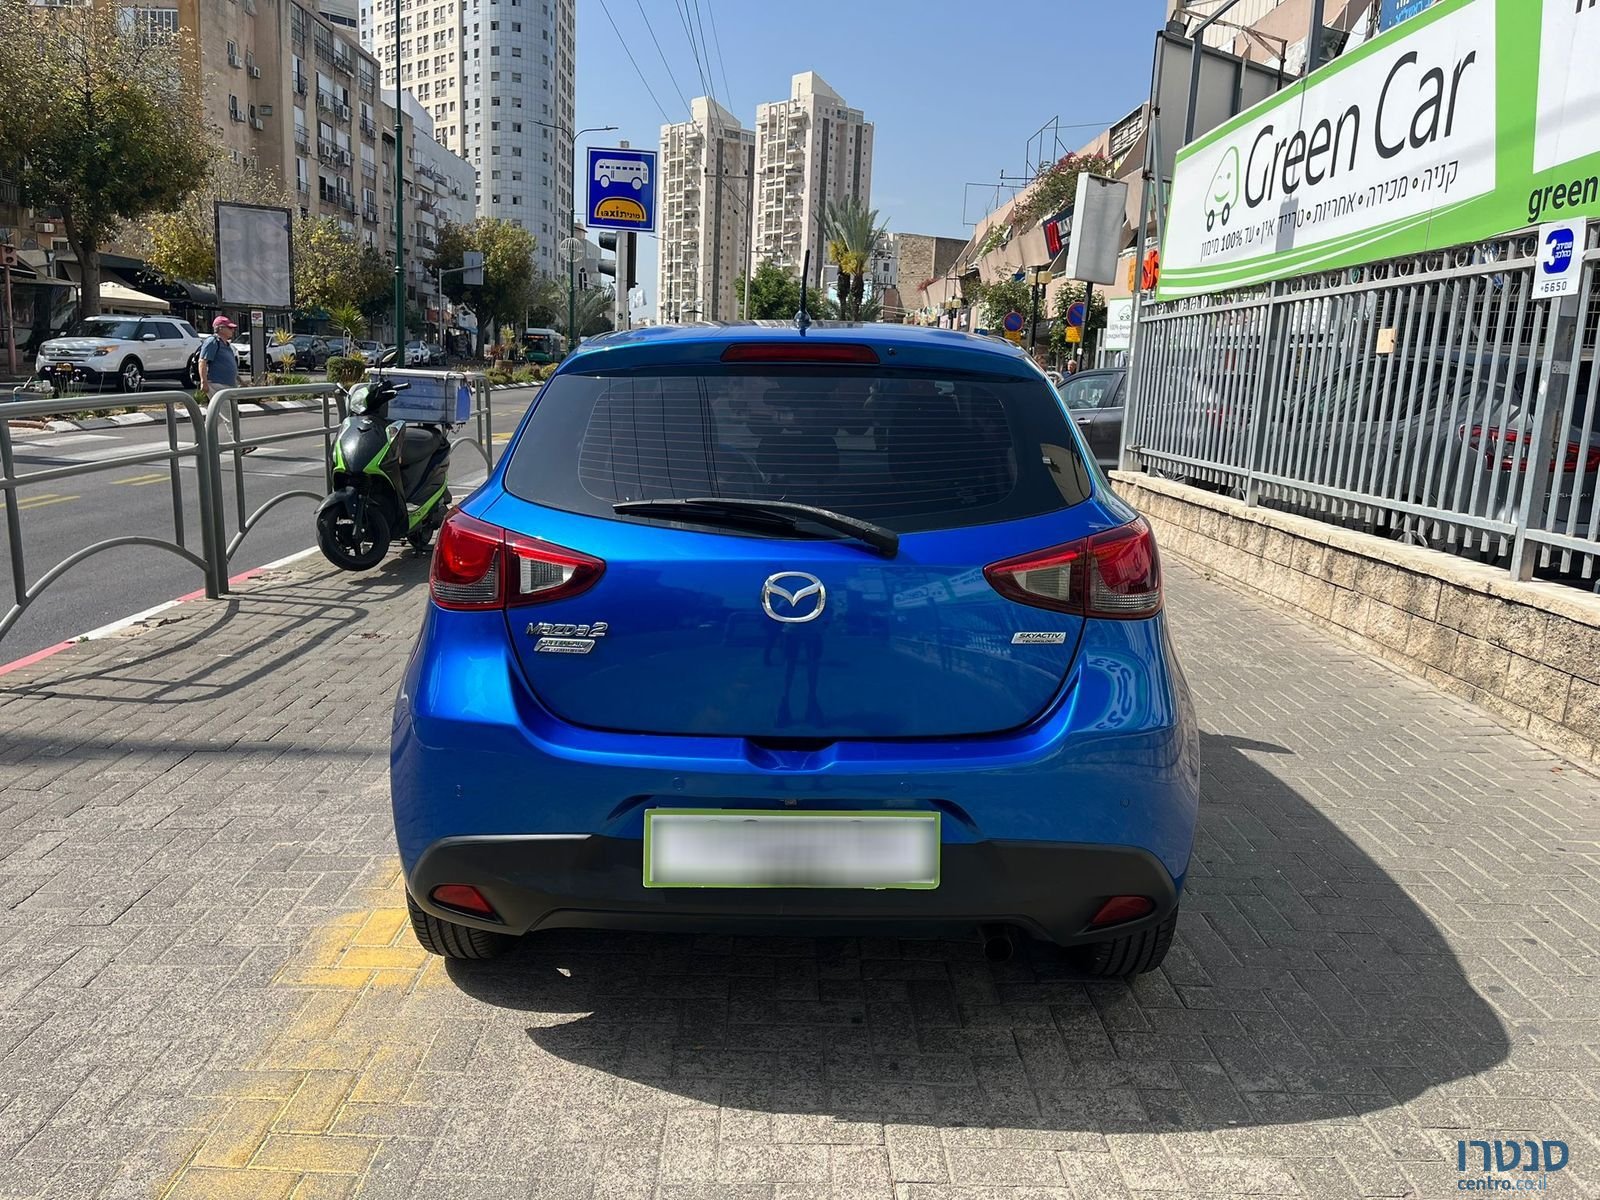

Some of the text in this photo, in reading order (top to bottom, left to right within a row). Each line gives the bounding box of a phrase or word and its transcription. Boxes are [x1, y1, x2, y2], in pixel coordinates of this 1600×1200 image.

[1245, 104, 1360, 208] Green
[1374, 50, 1476, 159] Car
[620, 211, 640, 219] מונית
[1199, 160, 1459, 263] קניה מכירה אחריות טרייד אין עד 100% מימון
[1527, 175, 1598, 223] green
